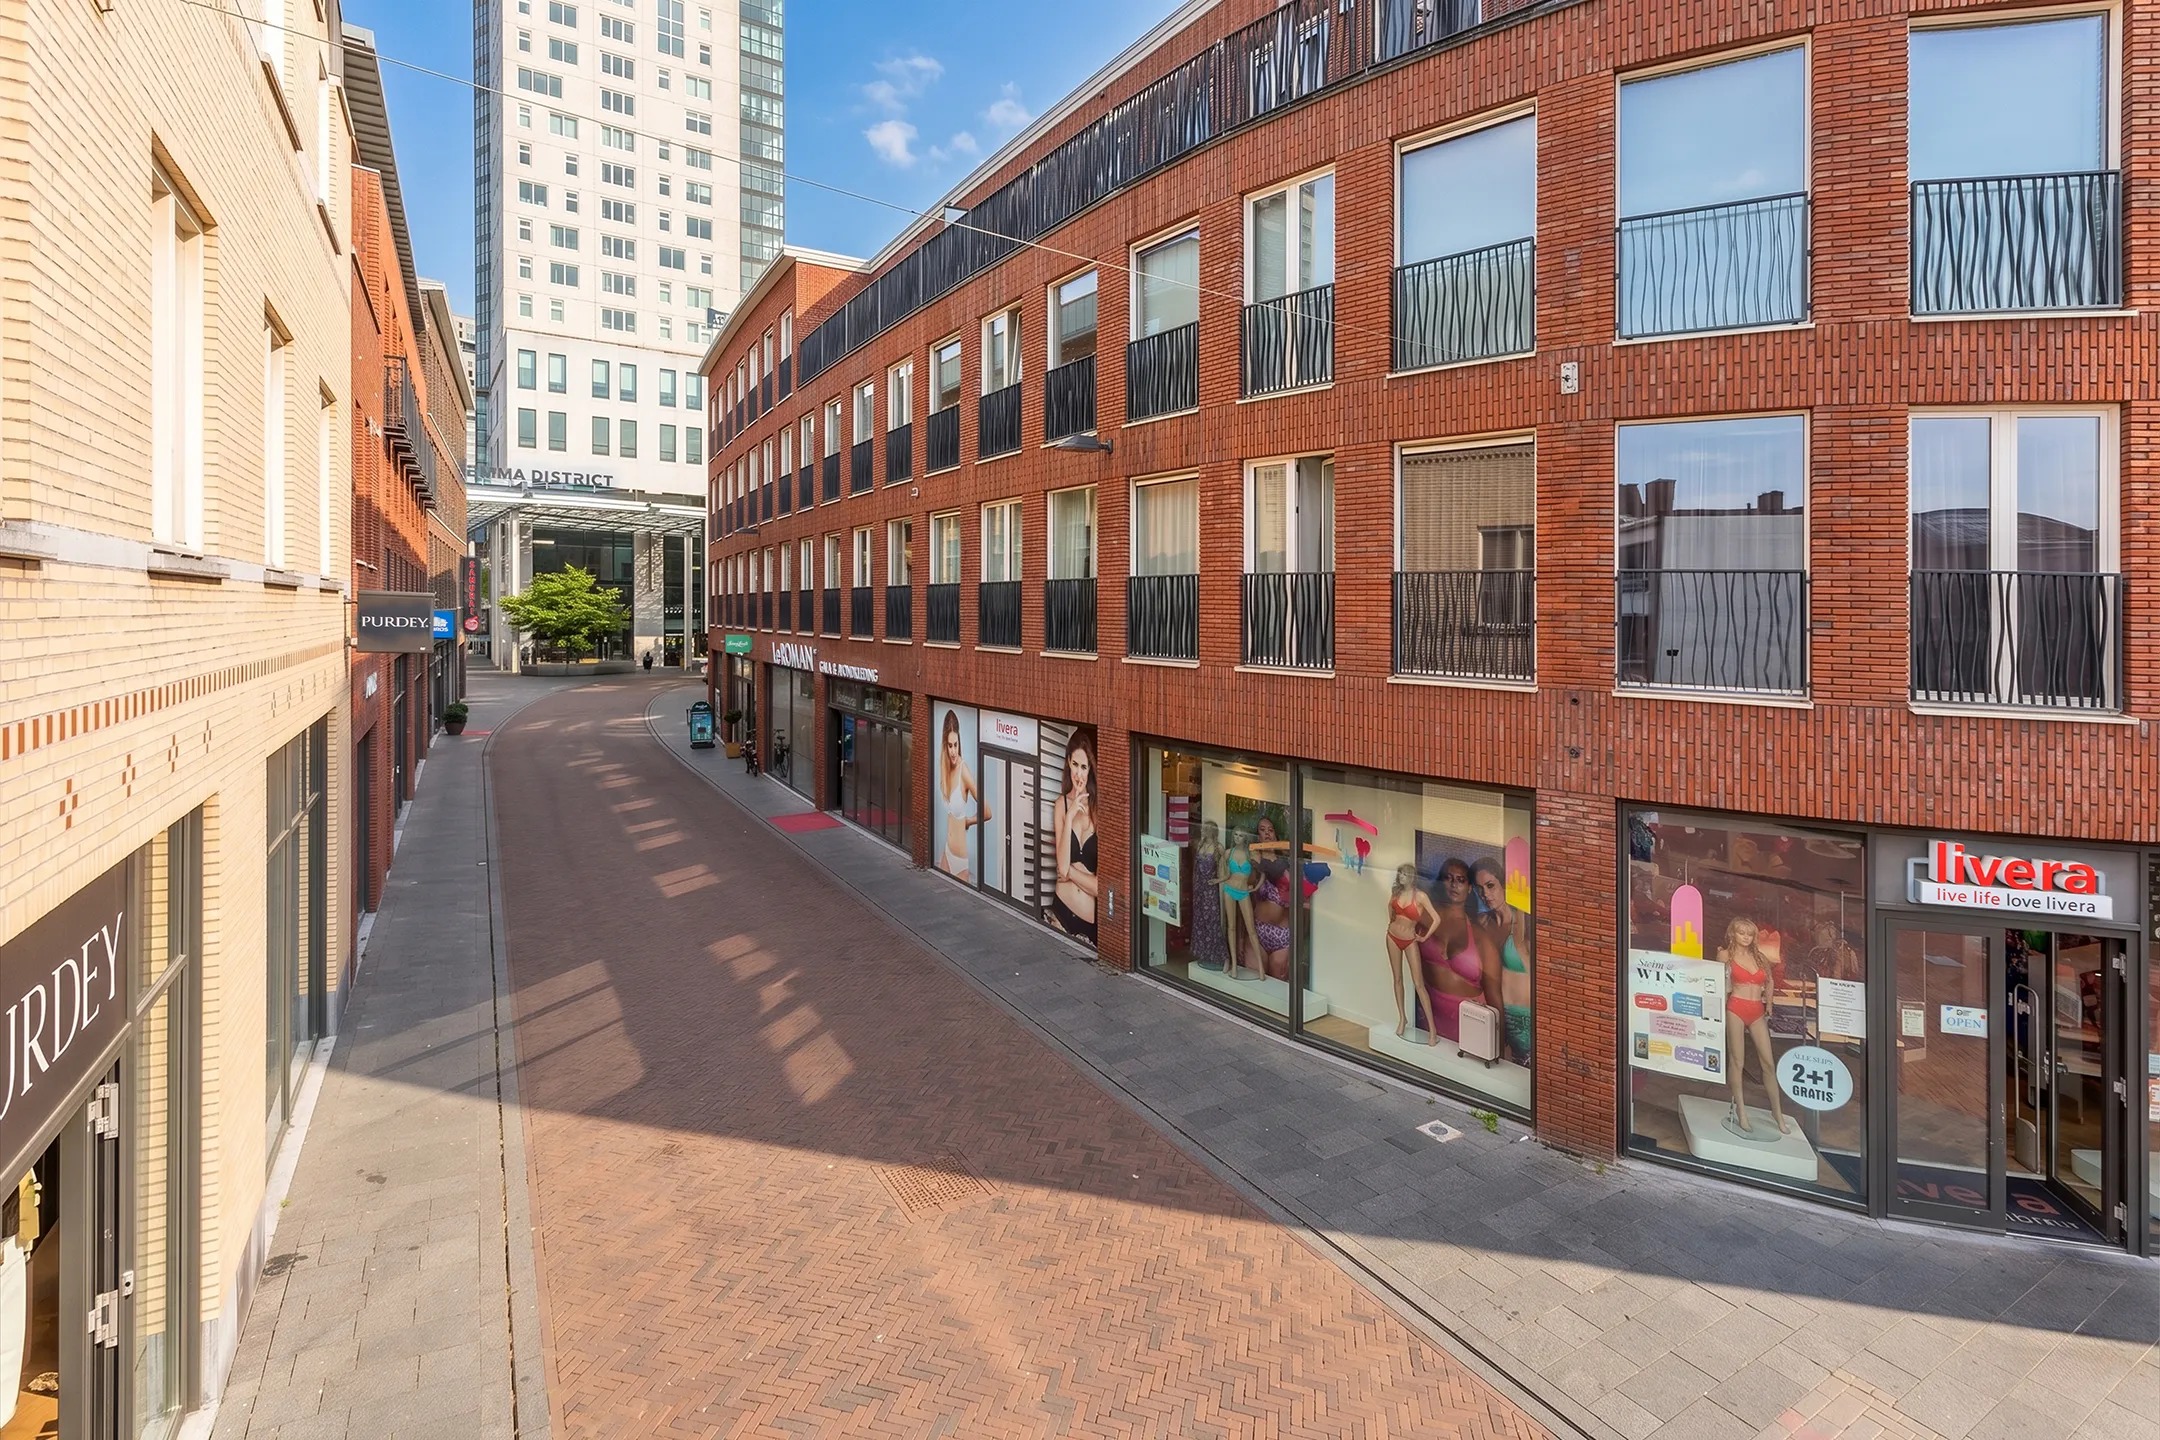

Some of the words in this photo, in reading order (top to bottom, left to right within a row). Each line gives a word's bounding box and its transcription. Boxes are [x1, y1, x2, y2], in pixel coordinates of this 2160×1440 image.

[532, 469, 614, 487] DISTRICT
[996, 718, 1019, 736] livera
[1936, 840, 2096, 895] livera
[1937, 887, 1968, 903] live
[1973, 890, 2001, 906] life
[2006, 893, 2042, 910] love
[2046, 896, 2097, 914] livera
[1638, 959, 1665, 970] Swim
[1636, 967, 1676, 984] WIN
[1946, 1016, 1982, 1029] OPEN
[1792, 1063, 1834, 1090] 2+1
[1792, 1084, 1834, 1103] GRATIS
